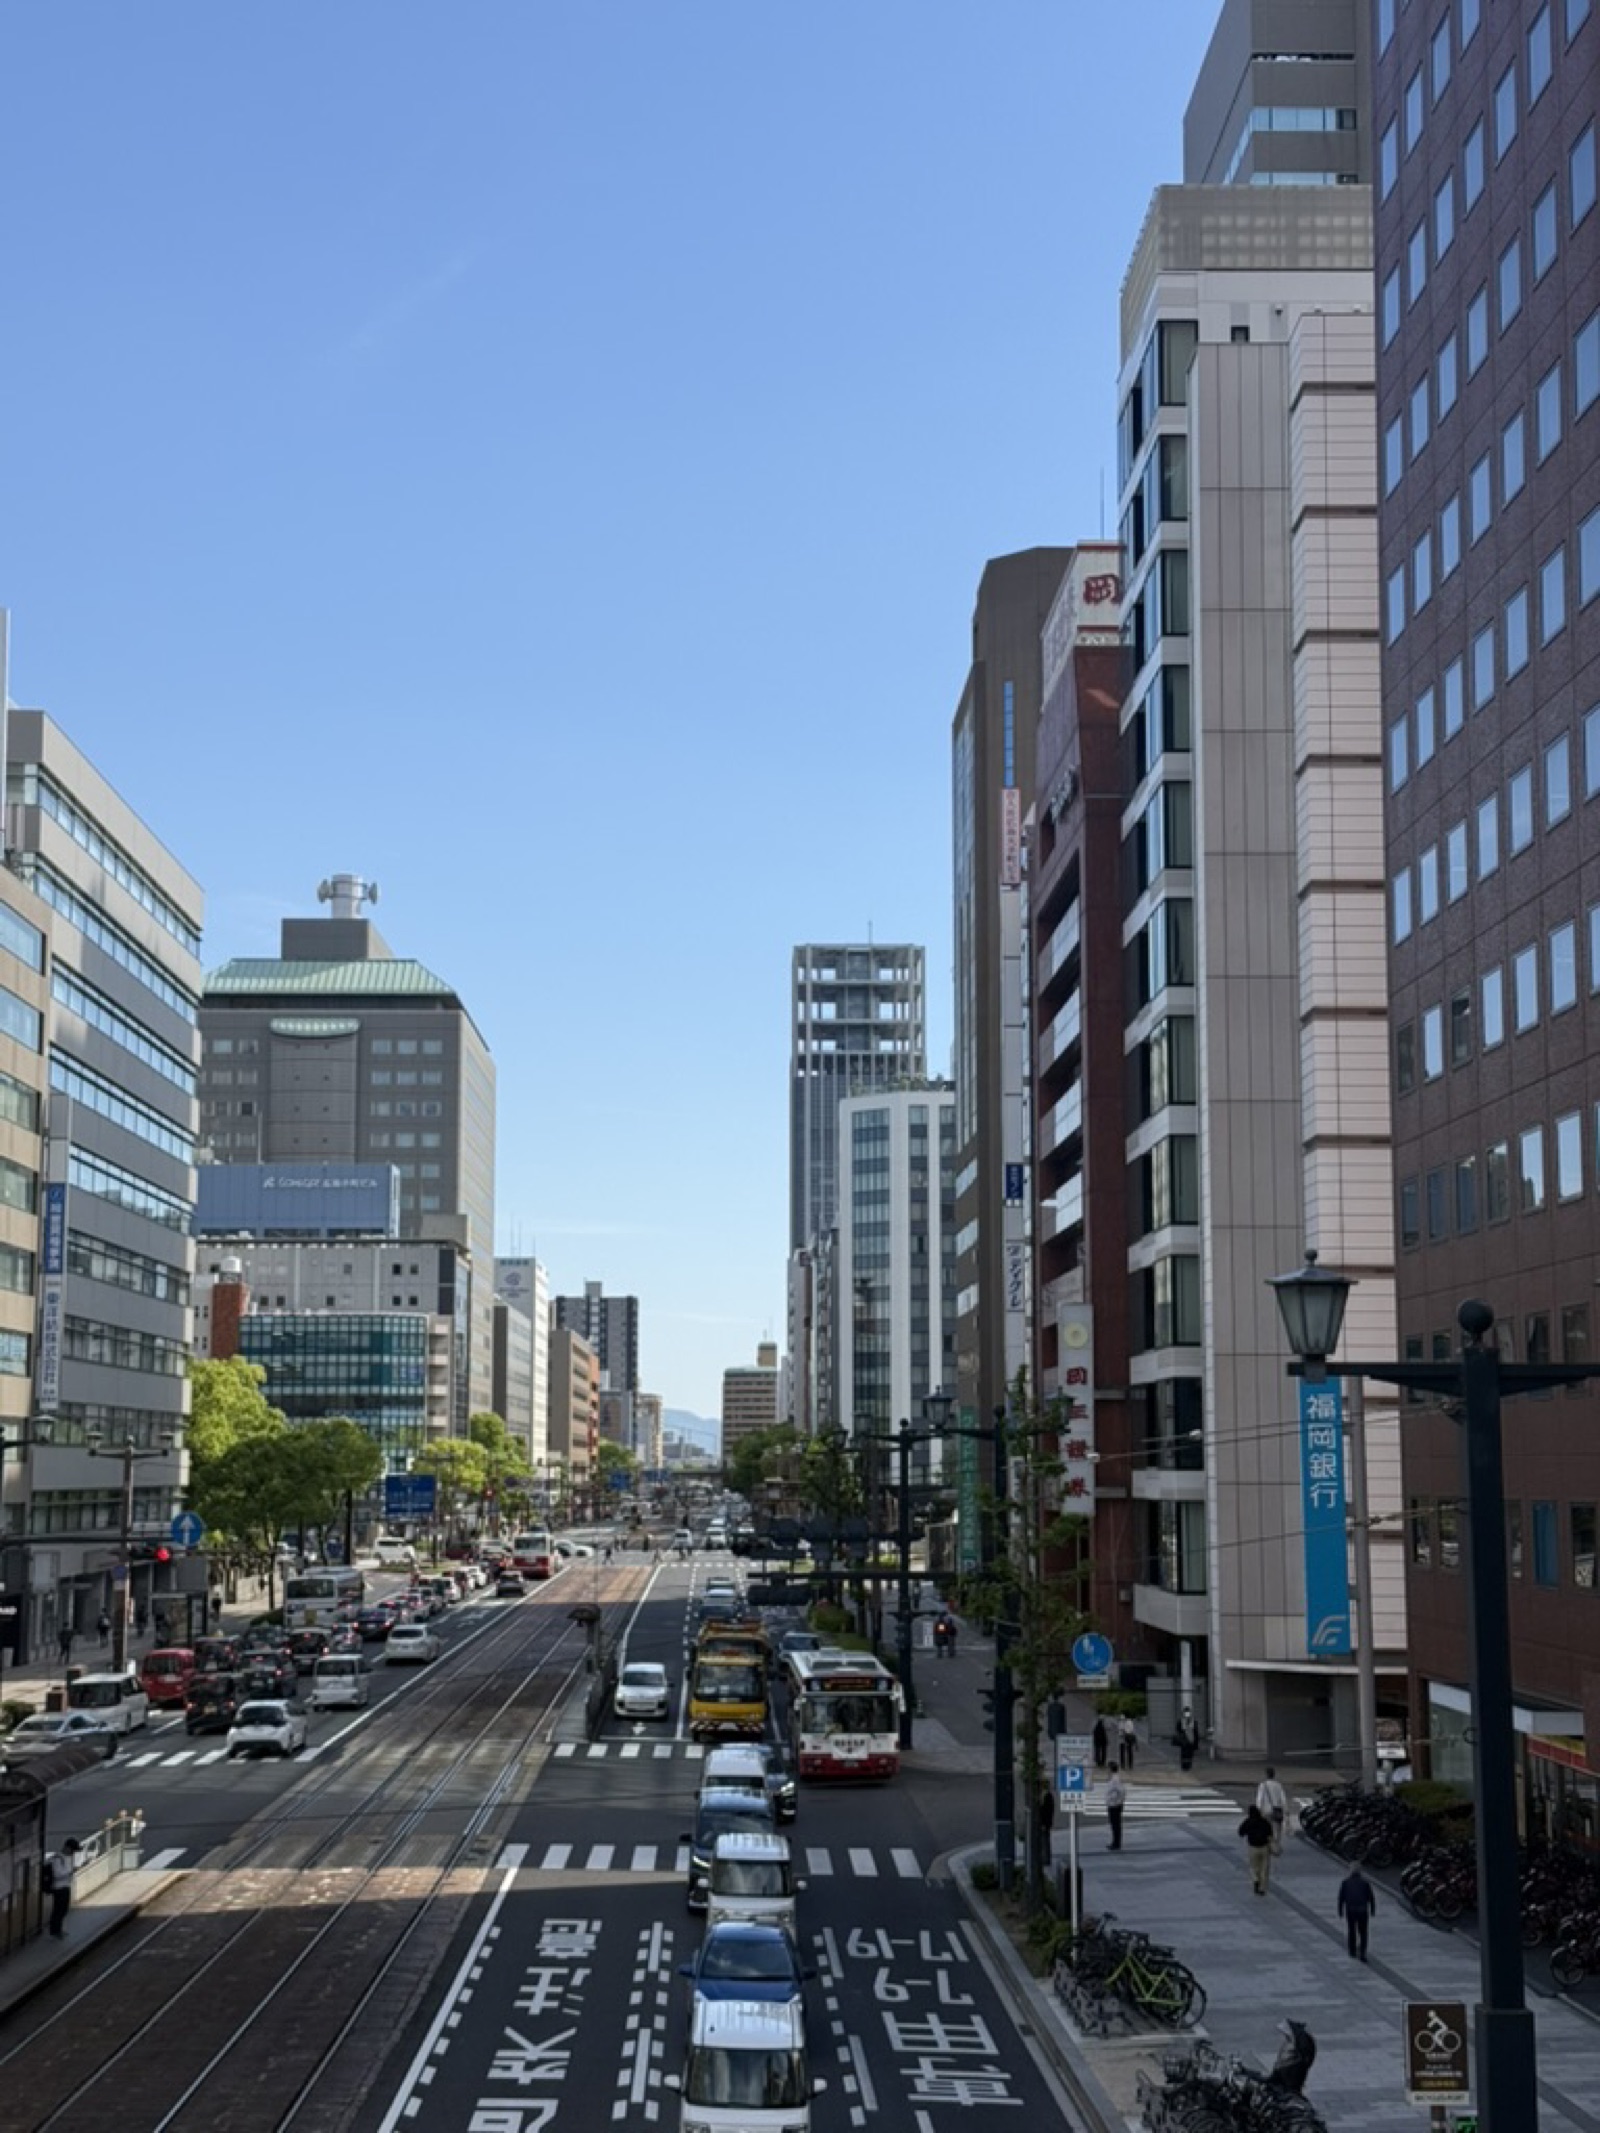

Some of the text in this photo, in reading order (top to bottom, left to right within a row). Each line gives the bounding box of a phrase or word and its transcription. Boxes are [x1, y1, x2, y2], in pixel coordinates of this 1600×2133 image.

[1305, 1393, 1338, 1509] 福岡銀行
[1067, 1767, 1082, 1788] P
[846, 1927, 969, 1962] 17-19
[873, 1966, 975, 2005] 7-9
[881, 2011, 1024, 2106] 専用
